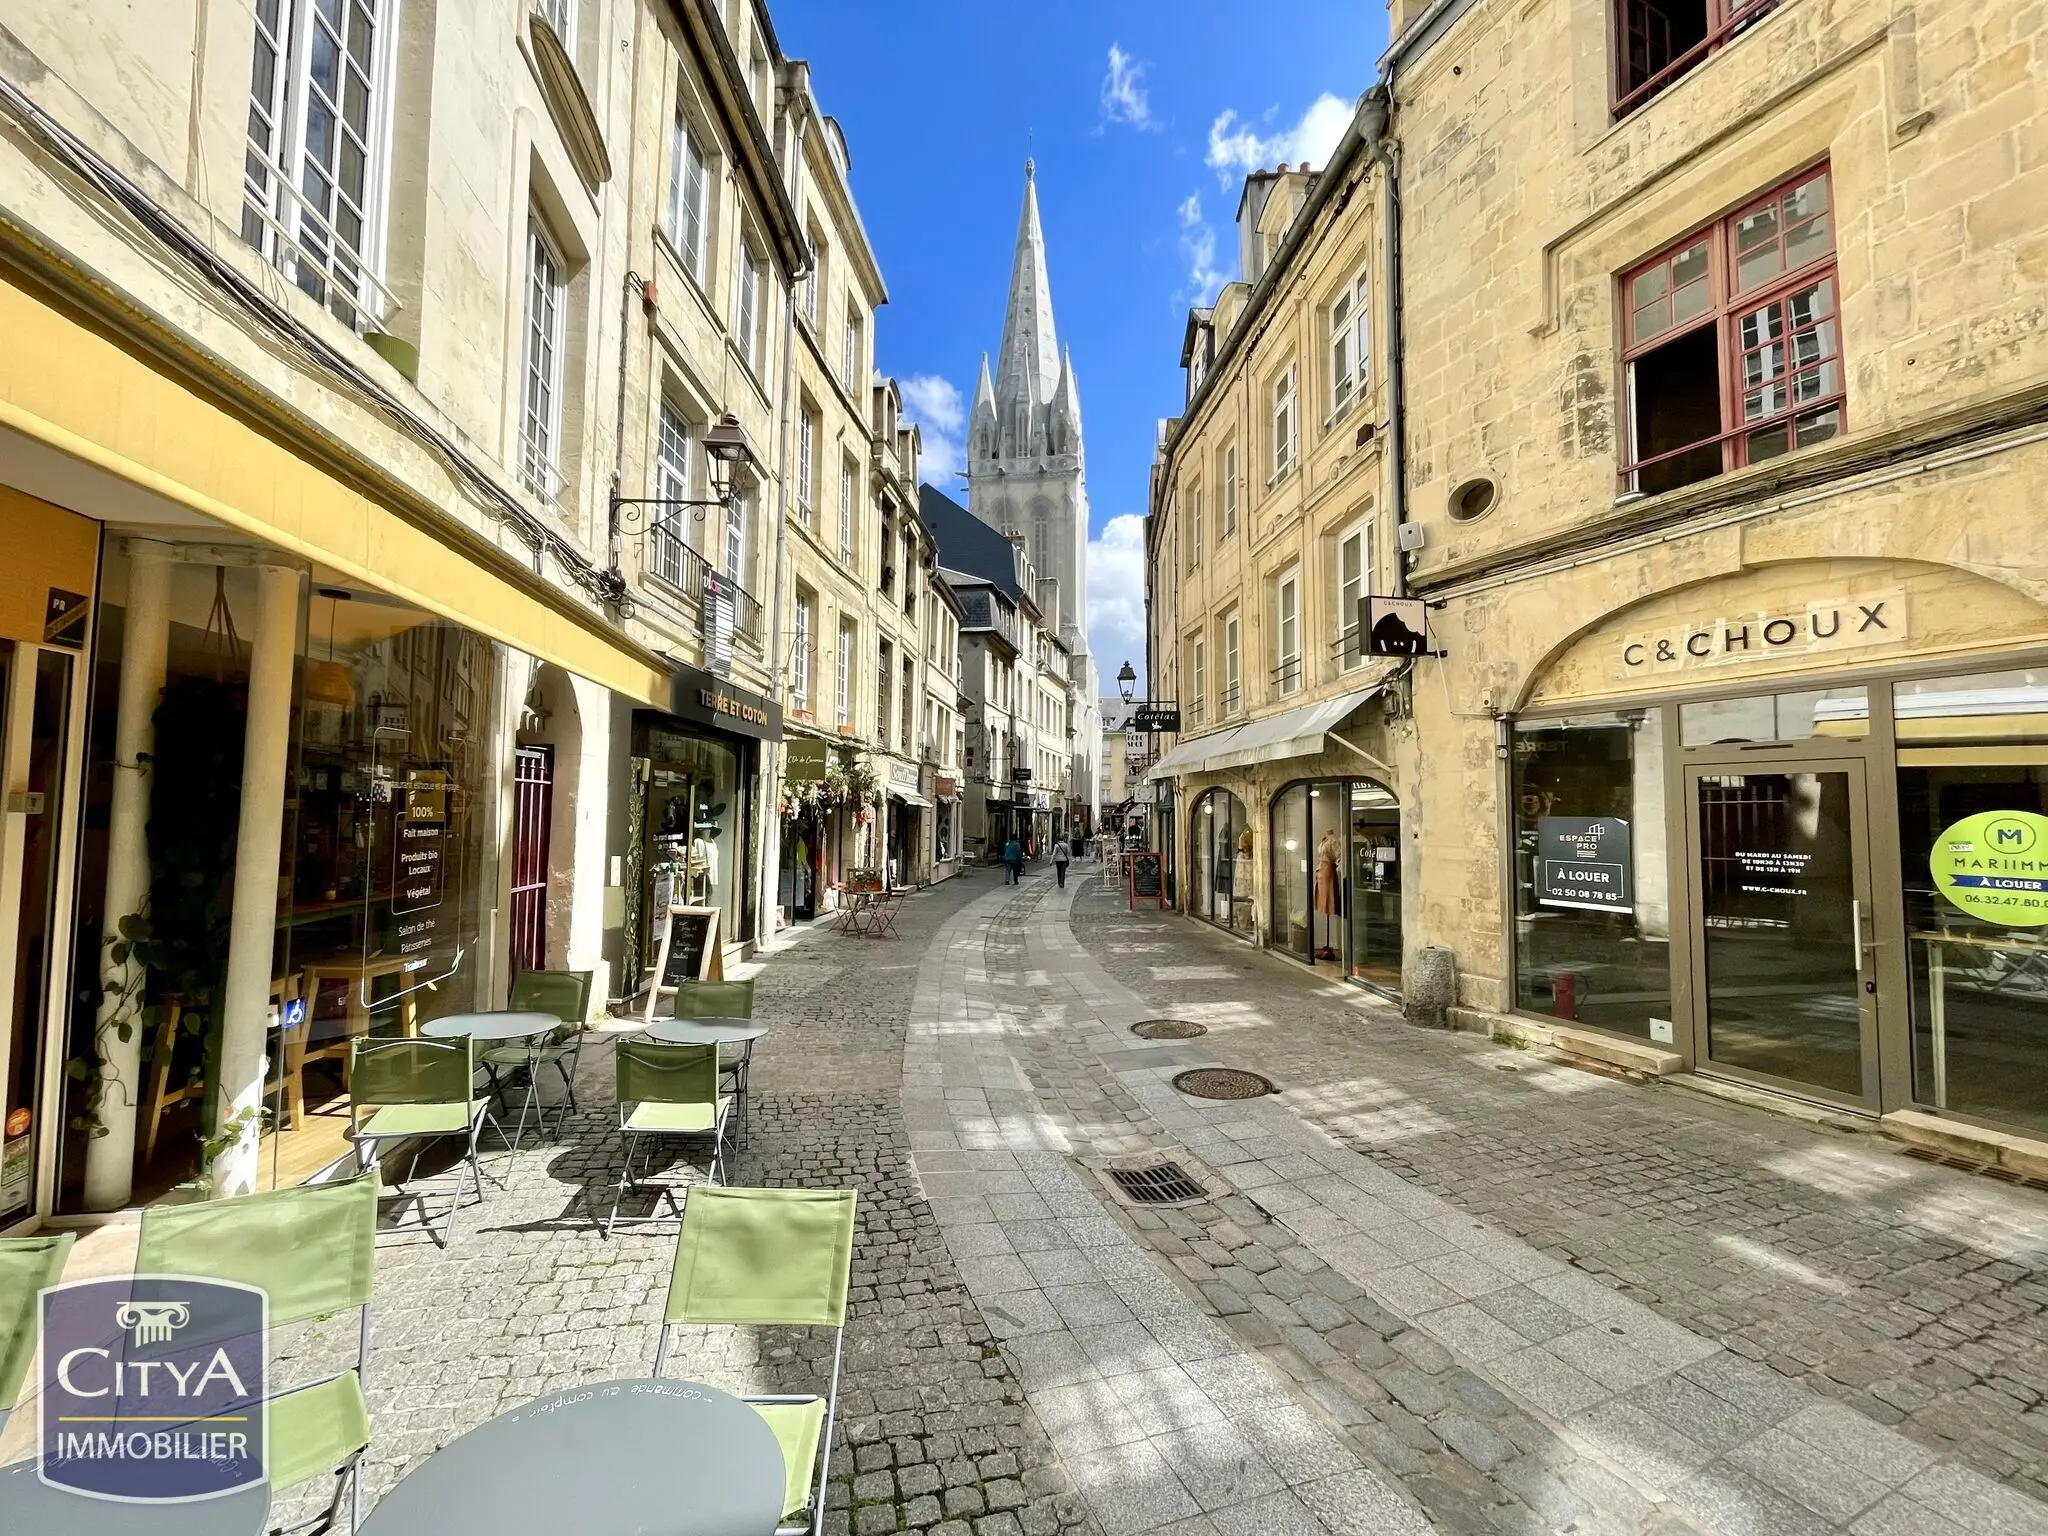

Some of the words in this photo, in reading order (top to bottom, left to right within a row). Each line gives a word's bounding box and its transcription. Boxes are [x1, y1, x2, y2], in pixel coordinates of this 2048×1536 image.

[1623, 602, 1888, 667] C&CHOUX
[700, 688, 728, 713] TERRE
[730, 700, 740, 717] ET
[742, 704, 768, 726] COTON
[412, 806, 434, 818] 100%
[404, 828, 416, 838] Fait
[417, 828, 438, 837] maison
[1559, 834, 1598, 843] ESPACE
[401, 852, 428, 863] Produits
[428, 850, 438, 860] bio
[408, 866, 431, 876] Locaux
[1557, 868, 1566, 880] À
[1568, 870, 1610, 883] LOUER
[1980, 876, 1991, 887] À
[1995, 879, 2042, 890] LOUER
[406, 886, 431, 899] Végétal
[1552, 887, 1563, 896] 02
[1564, 888, 1576, 897] 50
[1578, 890, 1590, 899] 08
[1592, 891, 1603, 900] 78
[1605, 892, 1618, 901] 85
[398, 925, 416, 937] Salon
[416, 922, 425, 932] de
[630, 1384, 702, 1400] commande
[529, 1391, 594, 1418] comptoir
